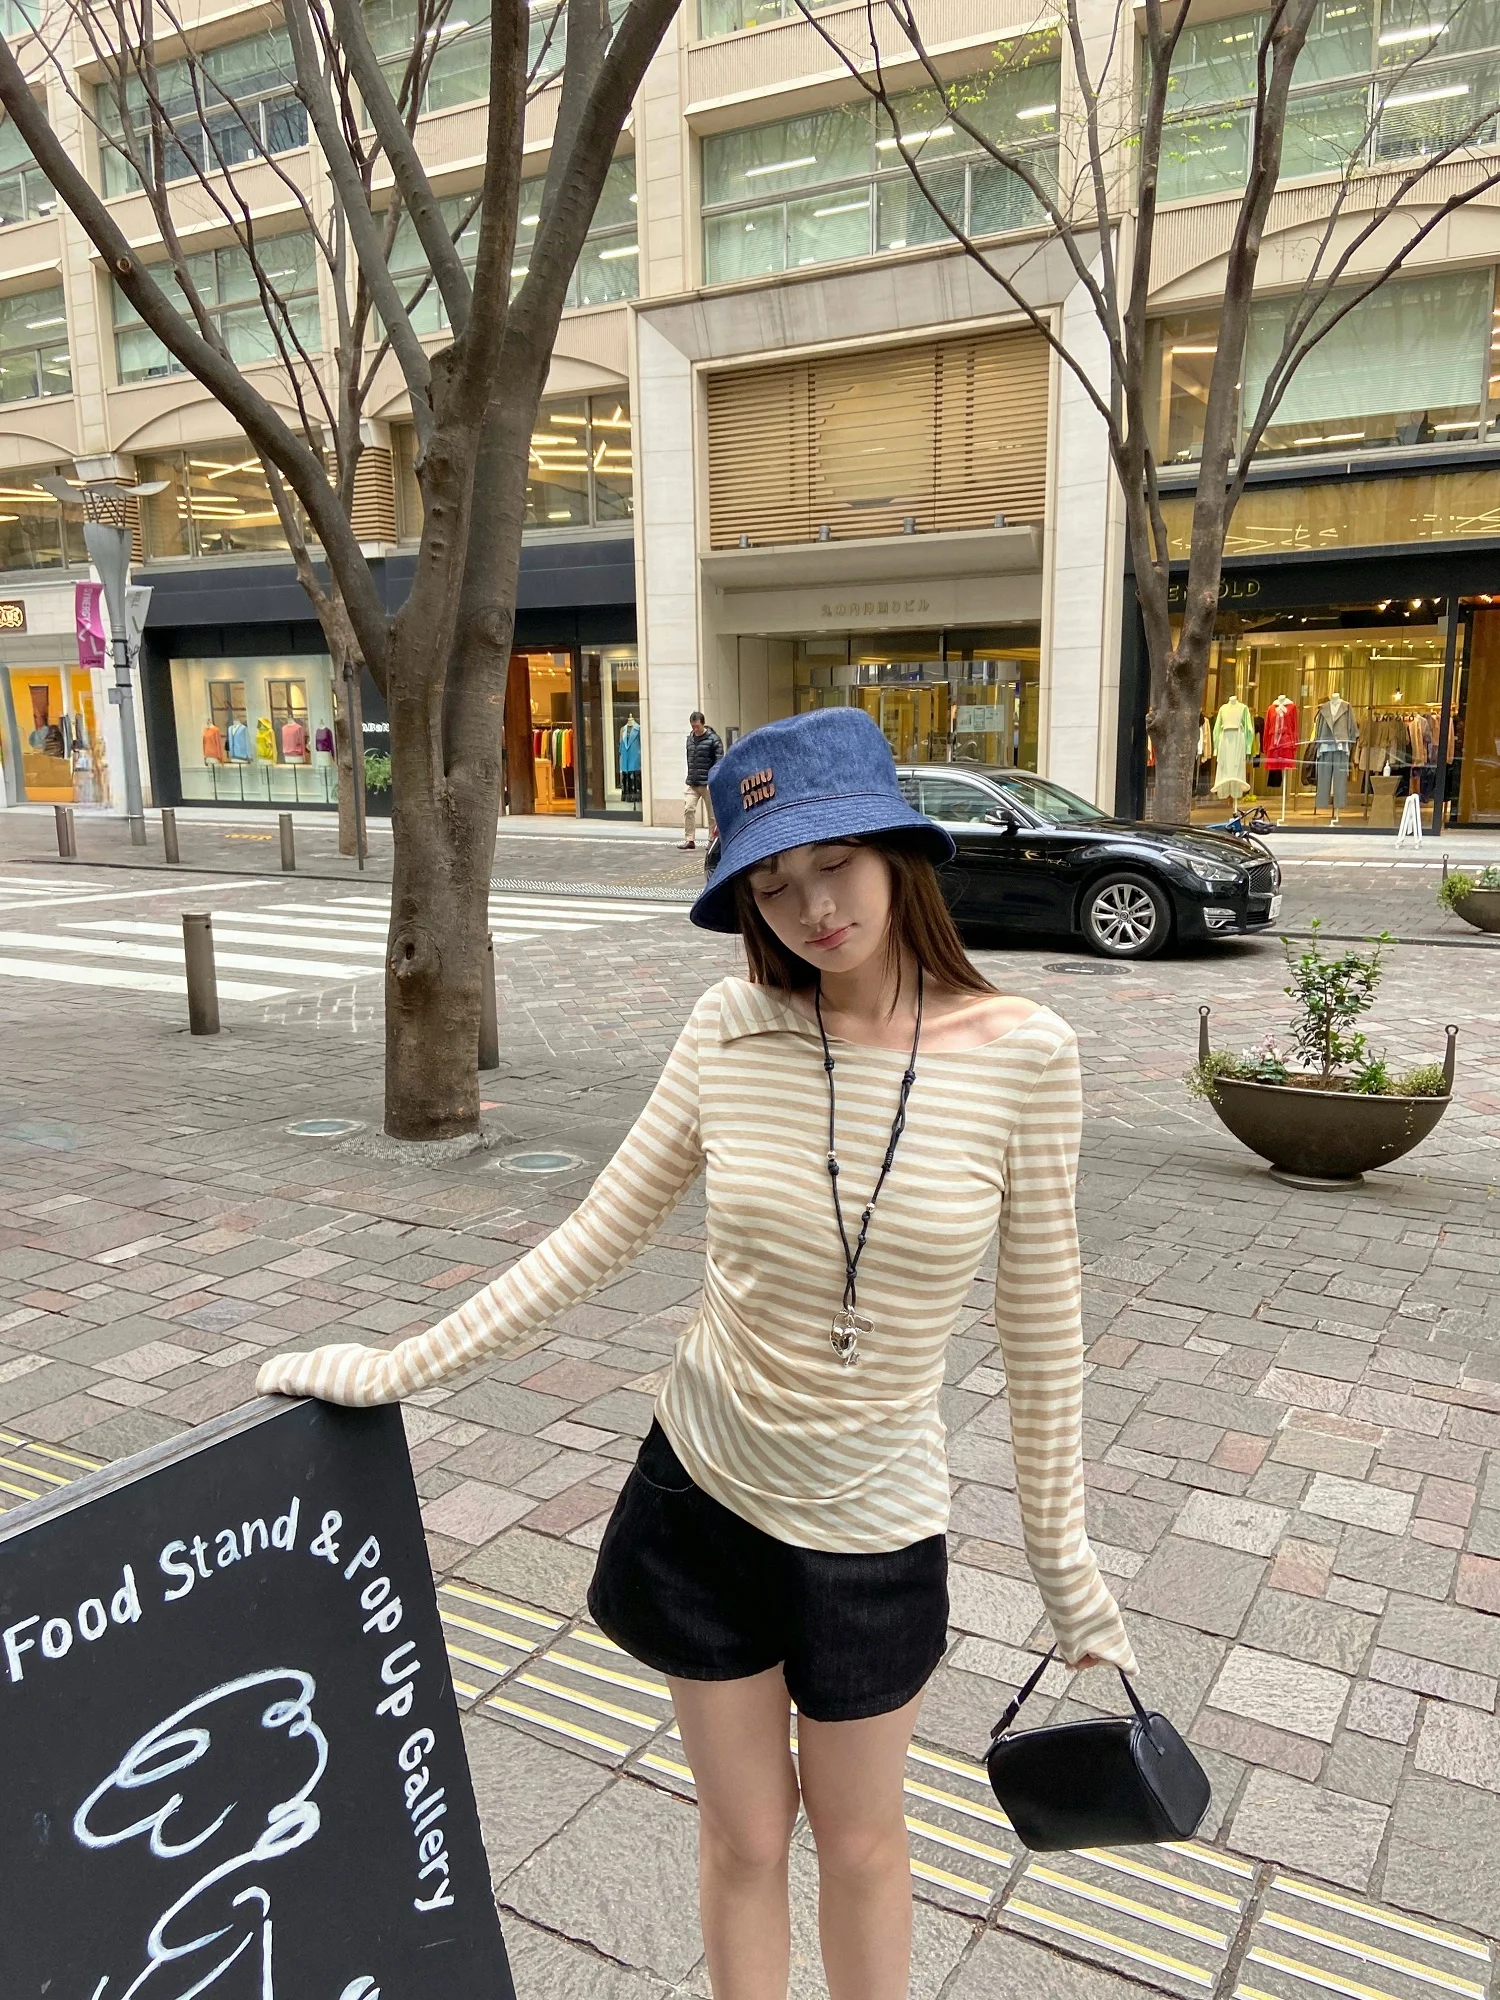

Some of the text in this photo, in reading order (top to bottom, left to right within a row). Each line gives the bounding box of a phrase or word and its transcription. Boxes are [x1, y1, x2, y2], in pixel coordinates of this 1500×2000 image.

[1, 1495, 455, 1912] Food Stand & Pop Up Gallery
